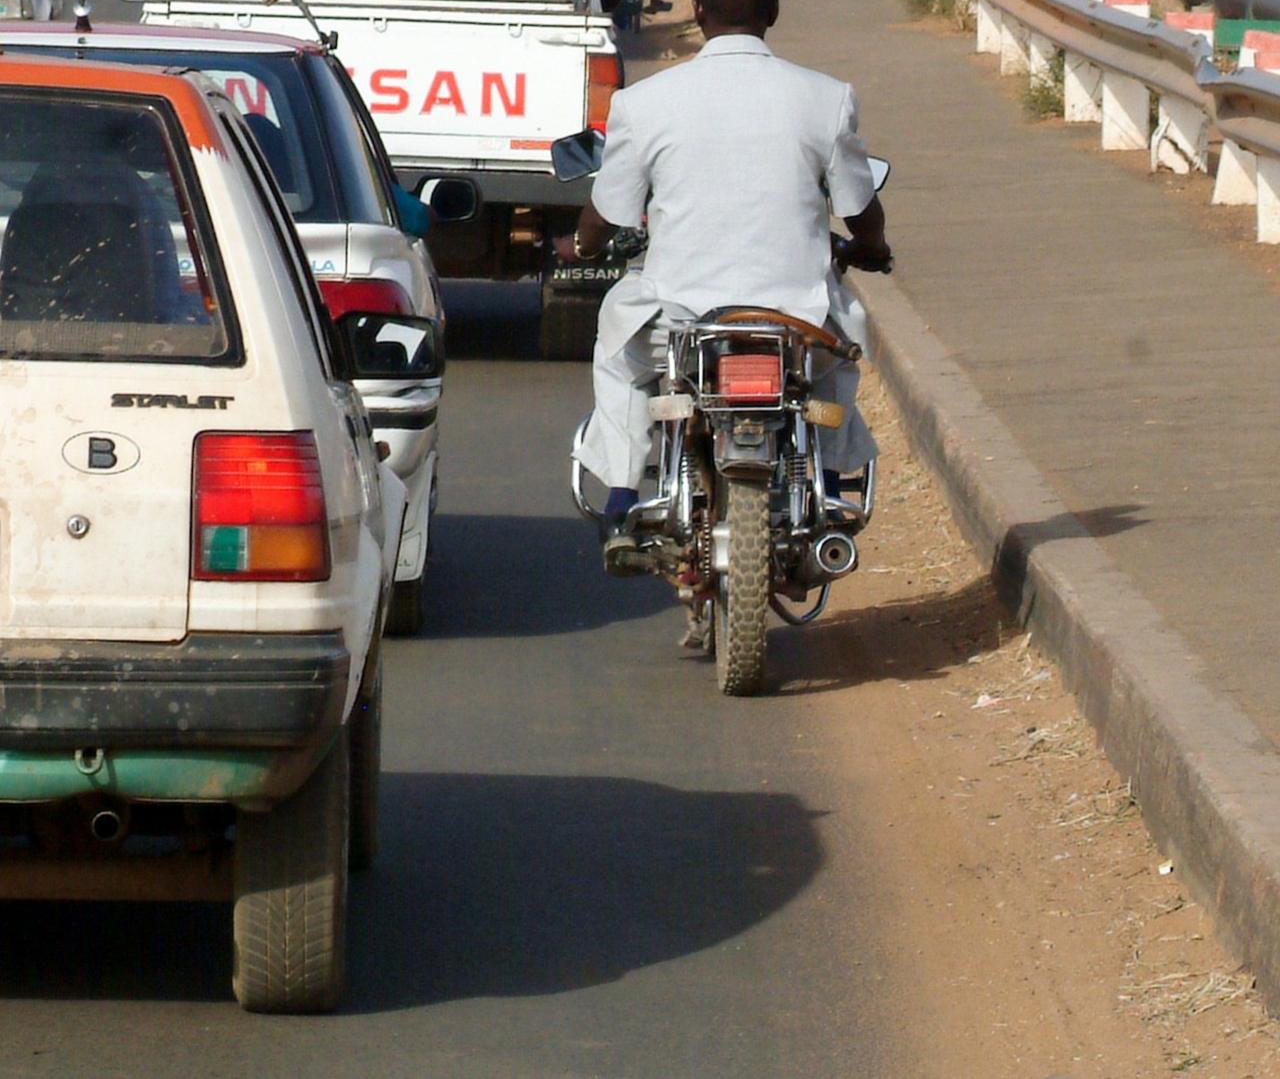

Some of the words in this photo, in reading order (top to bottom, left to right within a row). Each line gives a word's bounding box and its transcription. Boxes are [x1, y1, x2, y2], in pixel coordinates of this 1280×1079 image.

[553, 267, 620, 280] NISSAN
[111, 393, 235, 410] STARLET
[88, 436, 118, 469] B
